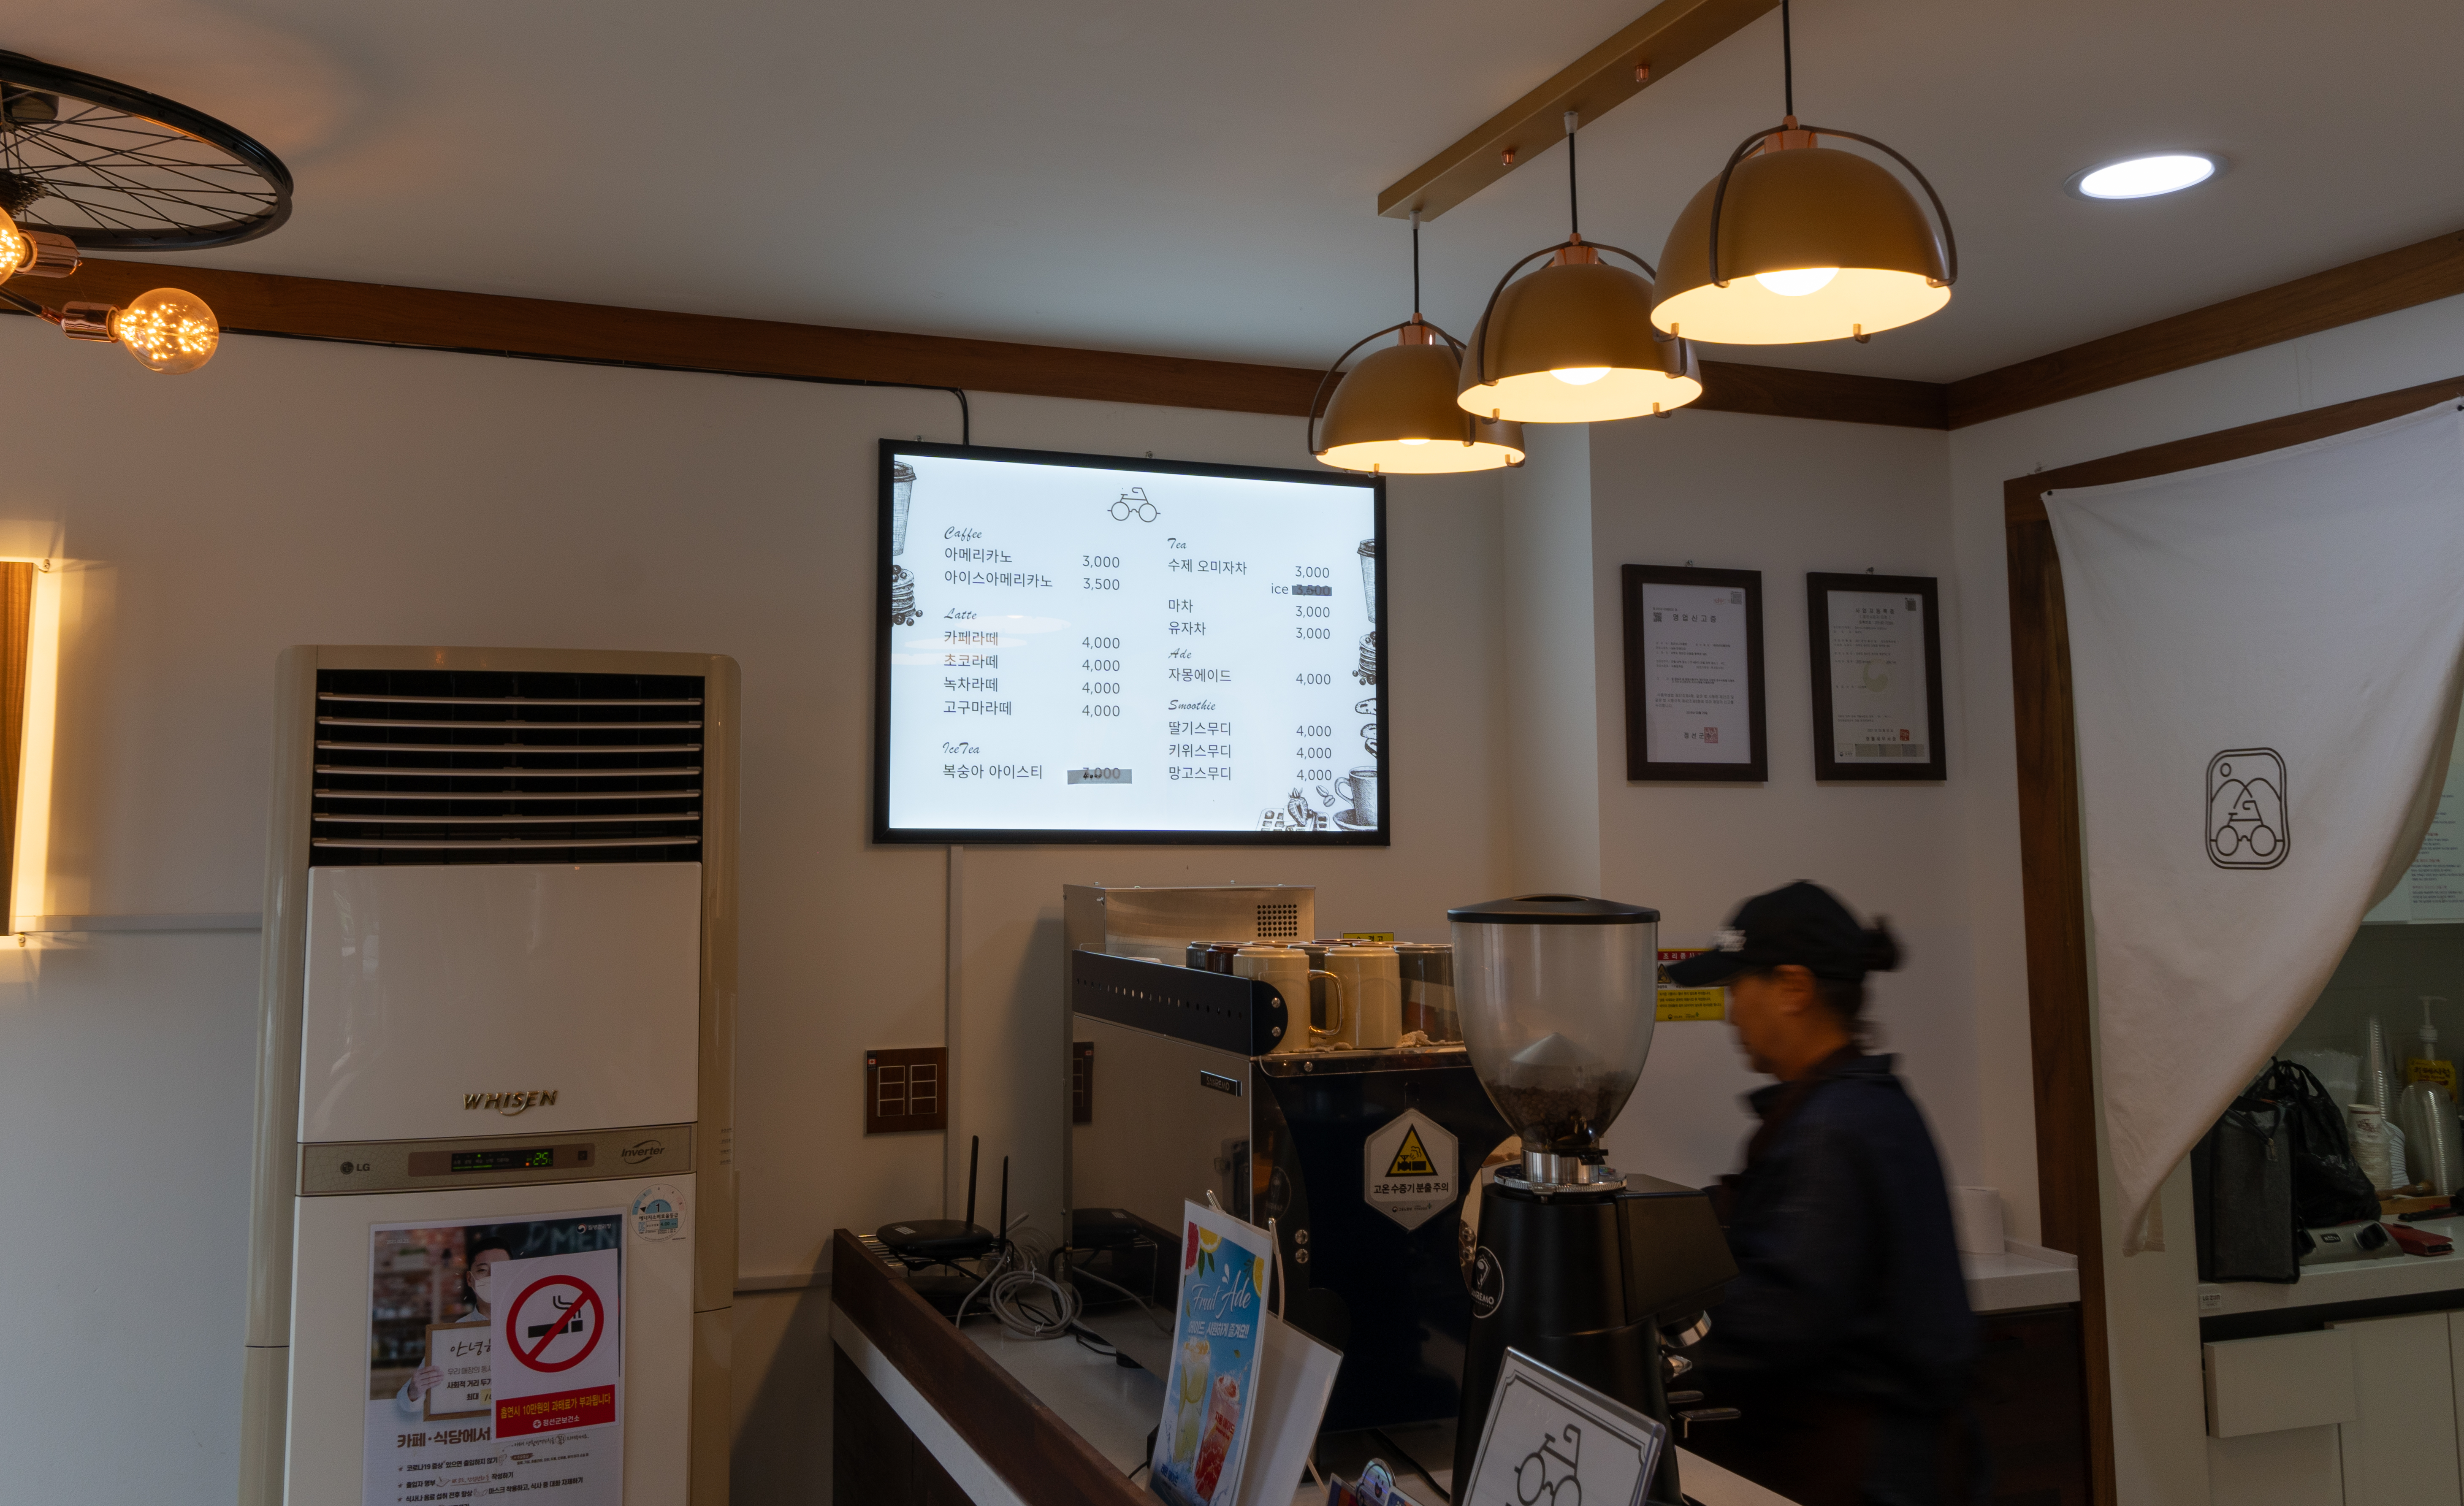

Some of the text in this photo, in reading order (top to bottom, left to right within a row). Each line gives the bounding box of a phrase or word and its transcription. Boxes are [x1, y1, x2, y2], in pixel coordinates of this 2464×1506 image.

[944, 526, 982, 542] Caffee
[1167, 537, 1186, 549] Tea
[945, 547, 1120, 568] 아메리카노 3,000
[1168, 558, 1329, 579] 수제 오미자차 3,000
[945, 570, 1120, 590] 아이스아메리카노 3,500
[1271, 583, 1289, 595] ice
[943, 607, 977, 620] Latte
[1168, 599, 1330, 618] 마차 3,000
[1672, 613, 1717, 623] 영업신고증
[1168, 621, 1330, 640] 유자차 3,000
[944, 630, 1120, 650] 카페라떼 4,000
[1168, 647, 1192, 659] Ade
[943, 654, 1120, 672] 초코라떼 4,000
[1168, 667, 1331, 685] 자몽에이드 4,000
[943, 677, 1120, 695] 녹차라떼 4,000
[943, 700, 1120, 718] 고구마라떼 4,000
[1168, 699, 1216, 710] Smoothie
[1169, 721, 1331, 738] 딸기스무디 4,000
[1169, 743, 1332, 760] 키위스무디 4,000
[943, 764, 984, 779] 복숭아
[989, 764, 1042, 780] 아이스티
[1169, 766, 1332, 782] 망고스무디 4,000
[1206, 1075, 1230, 1091] SANREMO
[462, 1090, 558, 1116] WHISEN
[621, 1145, 665, 1158] Inverter
[357, 1163, 370, 1172] LG
[1374, 1182, 1448, 1194] 고온 수증기 분출 주의
[656, 1203, 660, 1212] 1
[639, 1213, 678, 1221] 에너지소비효율등급
[1191, 1270, 1251, 1319] Fruit Ade
[1188, 1320, 1206, 1335] 에이드
[1206, 1322, 1229, 1337] 시원하게
[461, 1366, 480, 1374] 매장의
[447, 1380, 465, 1389] 사회적
[500, 1392, 611, 1419] 흡연시 10만원의 과태료가 부과됩니다
[542, 1414, 580, 1427] 정선군보건소
[1214, 1411, 1223, 1425] 자몽
[407, 1464, 431, 1472] 코로나19
[446, 1460, 462, 1468] 있으면
[464, 1458, 486, 1467] 출입하지
[487, 1456, 498, 1465] 않기
[491, 1471, 514, 1480] 작성하기
[406, 1494, 423, 1502] 식사나
[449, 1491, 460, 1499] 전후
[488, 1486, 506, 1495] 마스크
[506, 1484, 530, 1492] 착용하고,
[561, 1477, 583, 1485] 자제하기
